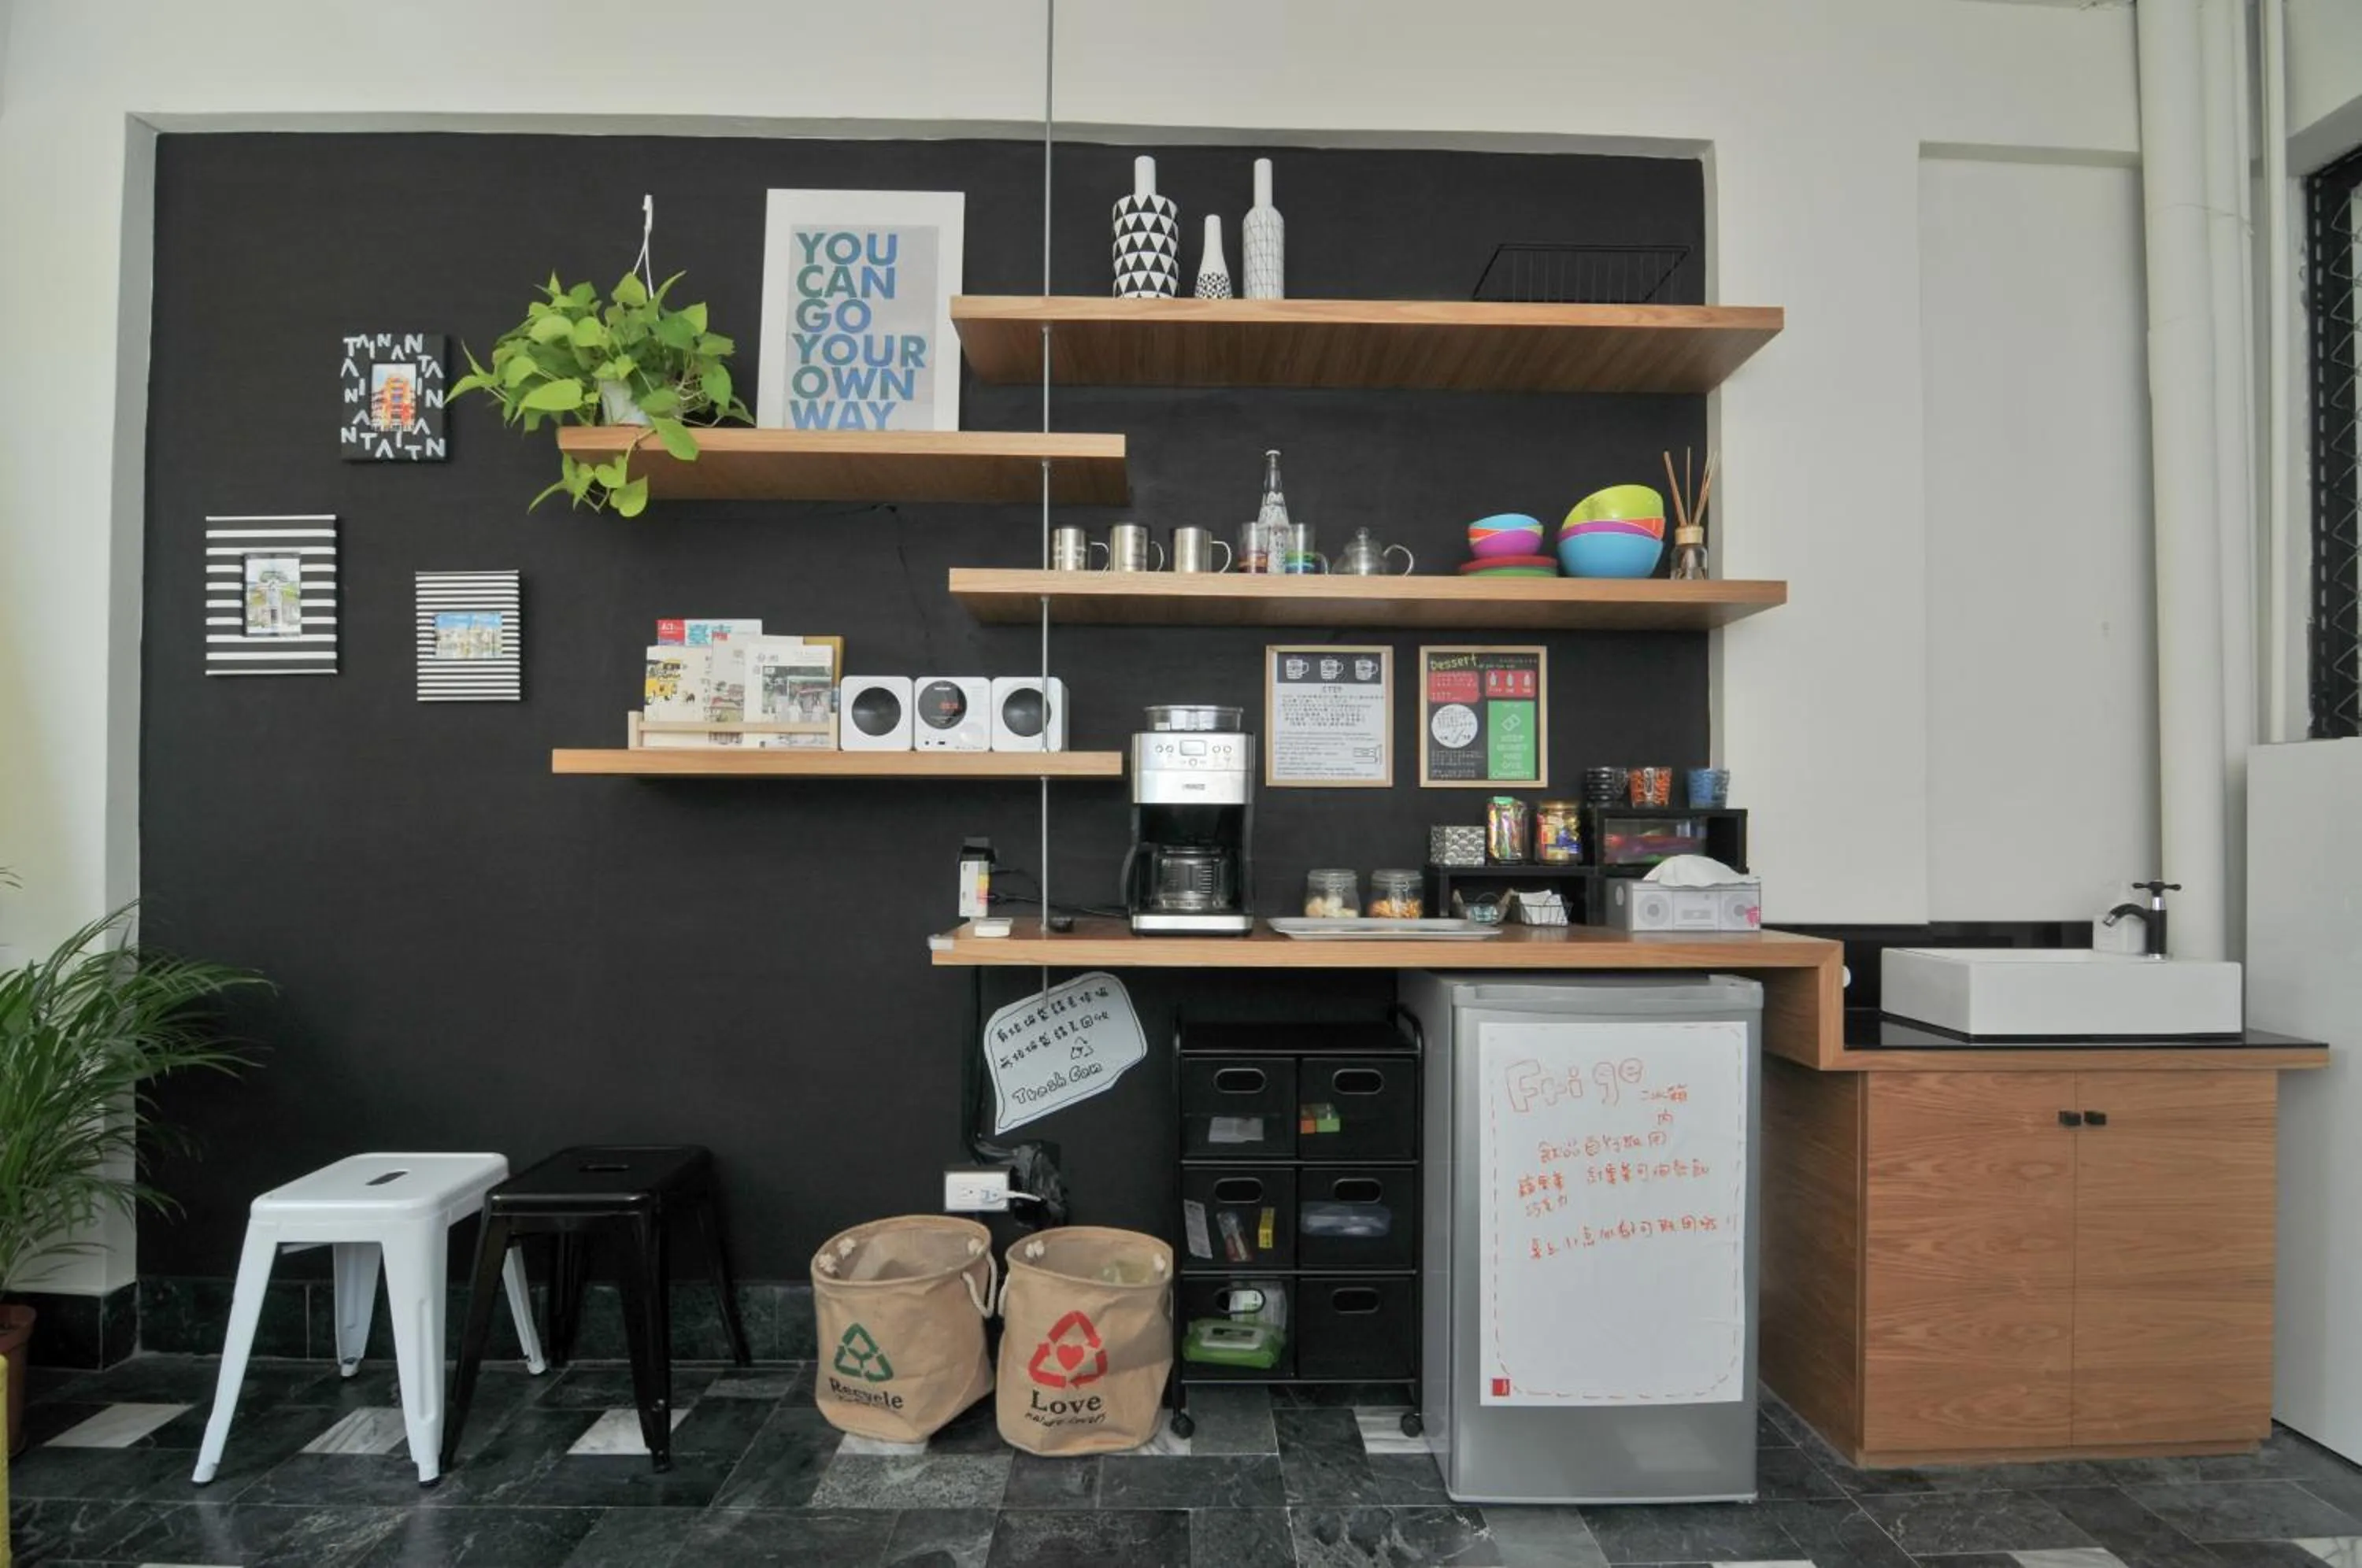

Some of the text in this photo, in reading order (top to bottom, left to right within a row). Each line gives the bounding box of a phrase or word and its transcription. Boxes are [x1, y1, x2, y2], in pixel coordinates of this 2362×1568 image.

[795, 231, 898, 266] YOU
[796, 264, 896, 299] CAN
[795, 298, 872, 334] GO
[791, 333, 927, 368] YOUR
[791, 365, 915, 401] OWN
[789, 400, 897, 430] WAY
[828, 1376, 905, 1410] Recycle
[1031, 1389, 1102, 1415] Love
